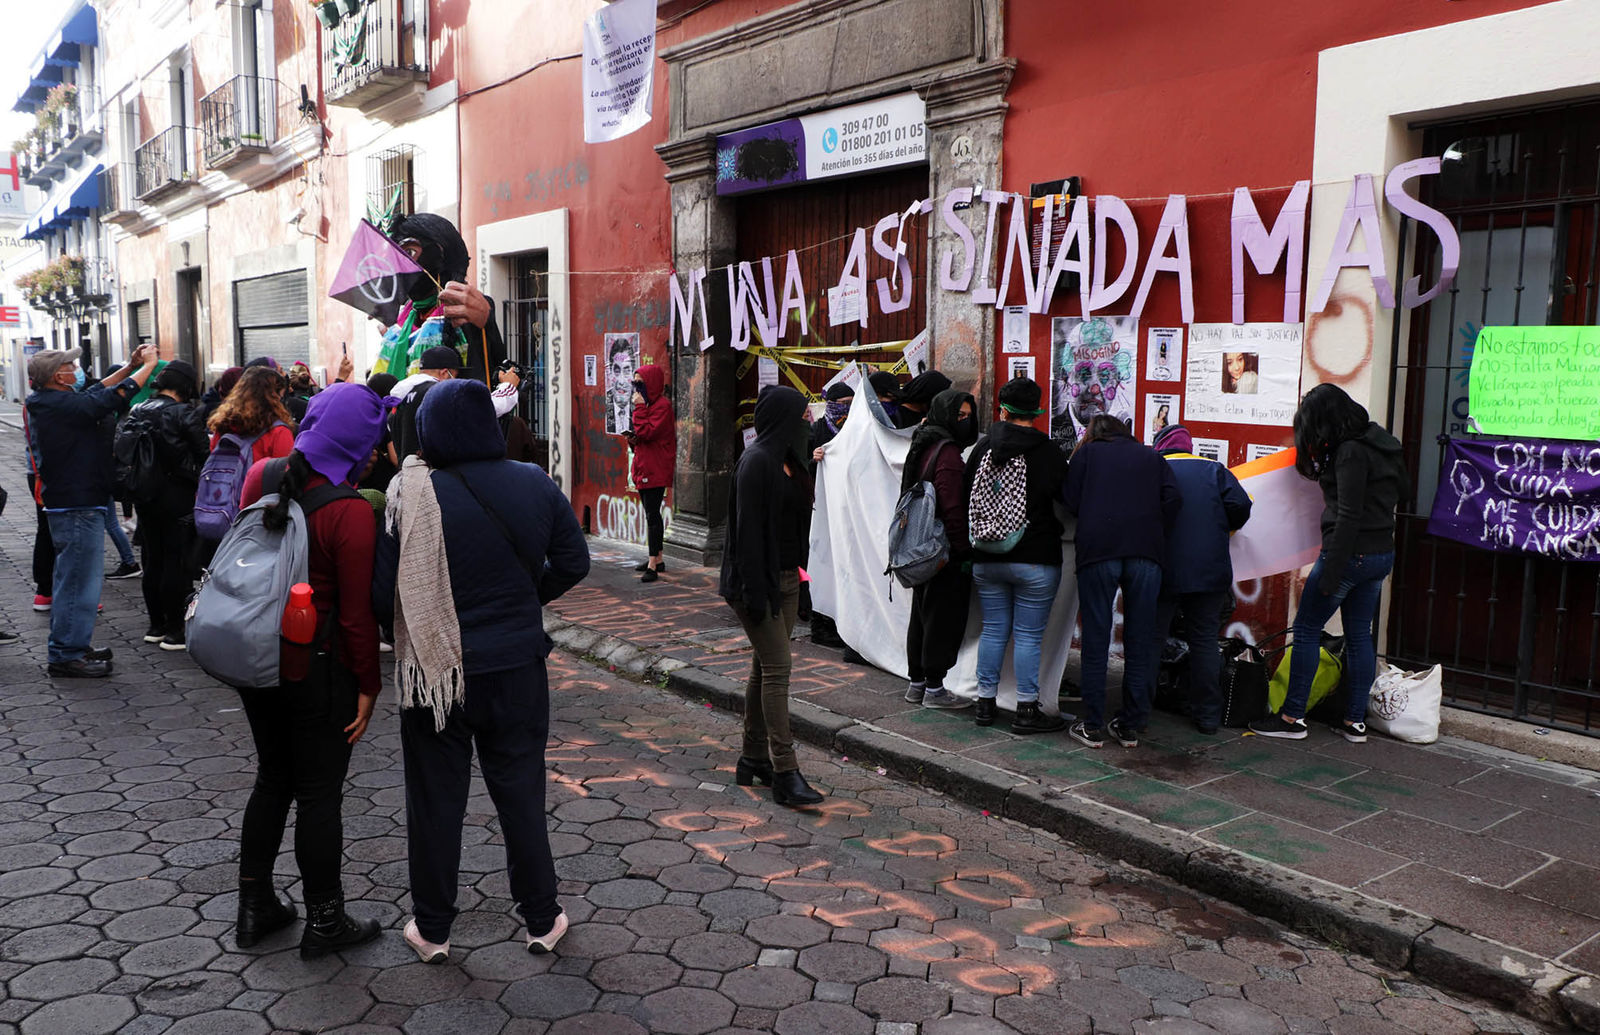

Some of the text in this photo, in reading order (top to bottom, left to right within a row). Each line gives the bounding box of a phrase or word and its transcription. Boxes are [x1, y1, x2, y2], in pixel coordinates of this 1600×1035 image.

[841, 122, 924, 153] 01800 201 01 05
[842, 113, 889, 136] 309 47 00
[821, 158, 851, 172] Atención
[852, 155, 863, 167] los
[864, 152, 877, 165] 365
[895, 145, 908, 158] del
[669, 266, 715, 351] NI
[1231, 156, 1459, 325] MAS
[1190, 328, 1204, 343] NO
[1207, 327, 1223, 339] HAY
[1266, 327, 1300, 342] JUSTICIA
[1072, 340, 1121, 362] MISOGINO
[1561, 445, 1600, 477] NO
[1494, 469, 1574, 499] CUIDA
[1482, 497, 1520, 524] ME
